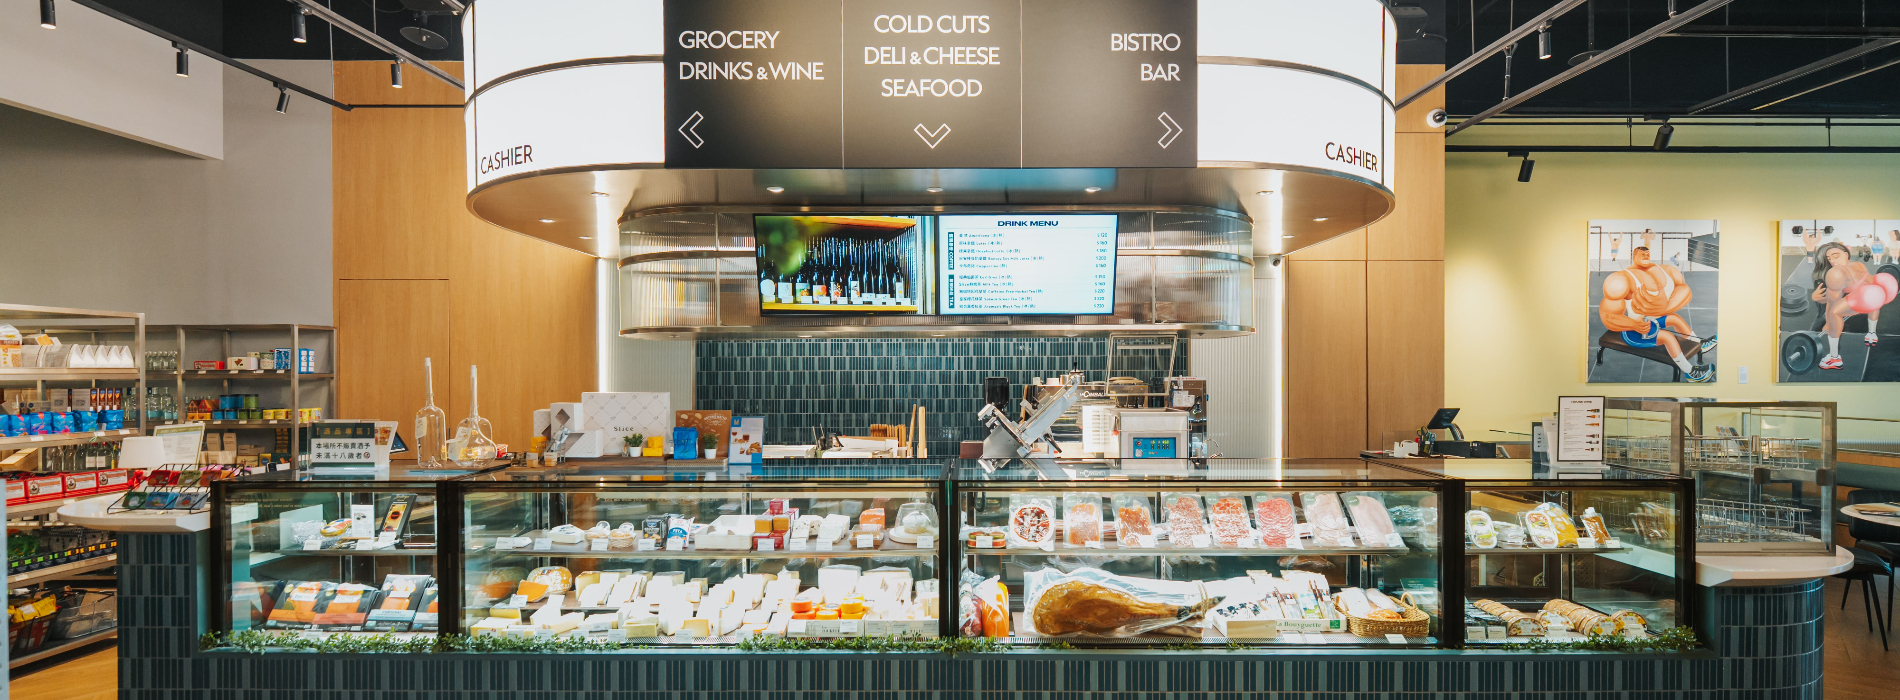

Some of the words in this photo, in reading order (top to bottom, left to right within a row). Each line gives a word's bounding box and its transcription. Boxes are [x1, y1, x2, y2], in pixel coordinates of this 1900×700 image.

[874, 14, 933, 34] COLD
[936, 14, 991, 34] CUTS
[678, 30, 780, 49] GROCERY
[1111, 33, 1181, 51] BISTRO
[864, 46, 906, 65] DELI
[909, 51, 922, 65] &
[923, 46, 1001, 65] CHEESE
[679, 61, 754, 80] DRINKS
[756, 66, 768, 80] &
[768, 61, 825, 80] WINE
[1140, 63, 1181, 81] BAR
[881, 78, 983, 97] SEAFOOD
[480, 144, 533, 174] CASHIER
[1325, 141, 1378, 173] CASHIER
